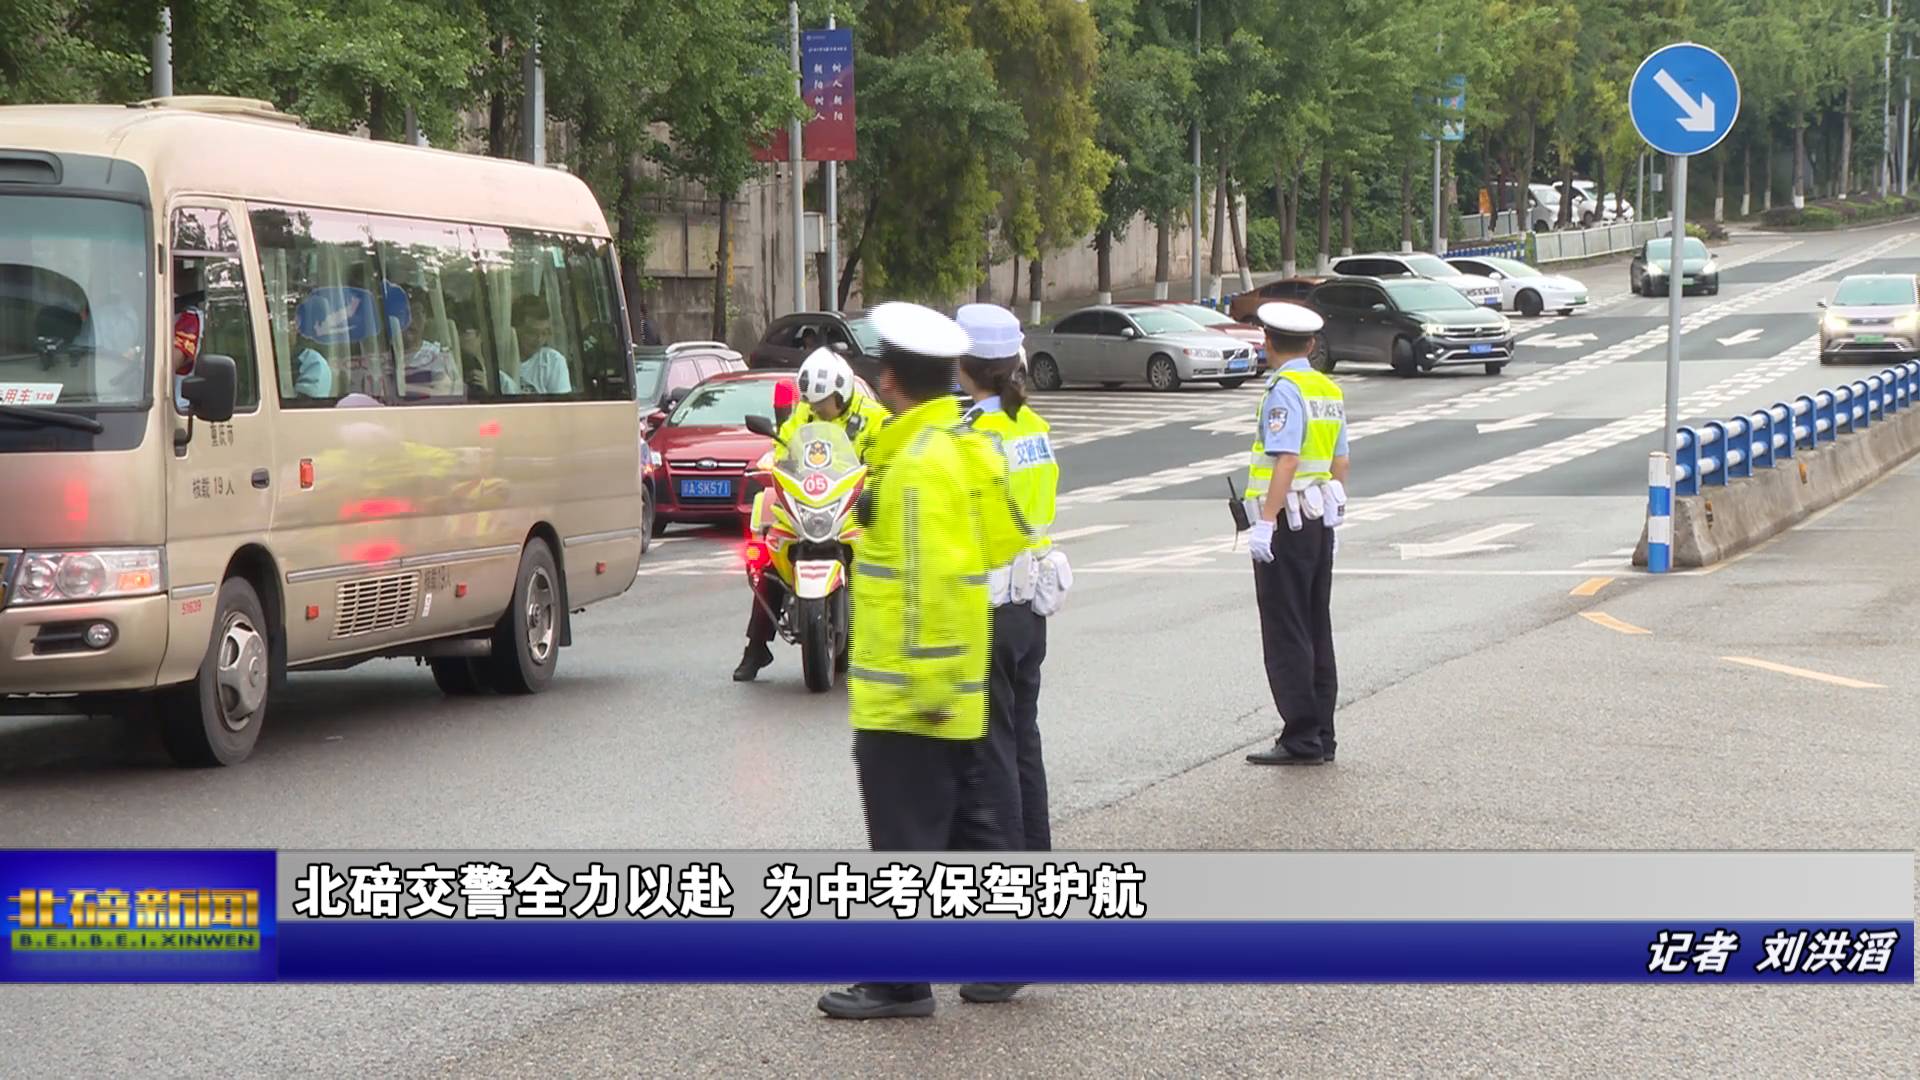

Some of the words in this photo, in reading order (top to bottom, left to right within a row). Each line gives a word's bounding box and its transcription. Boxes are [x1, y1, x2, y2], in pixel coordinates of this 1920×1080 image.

[832, 63, 843, 121] 树人朝阳
[0, 388, 32, 406] 用车
[805, 479, 826, 492] 05
